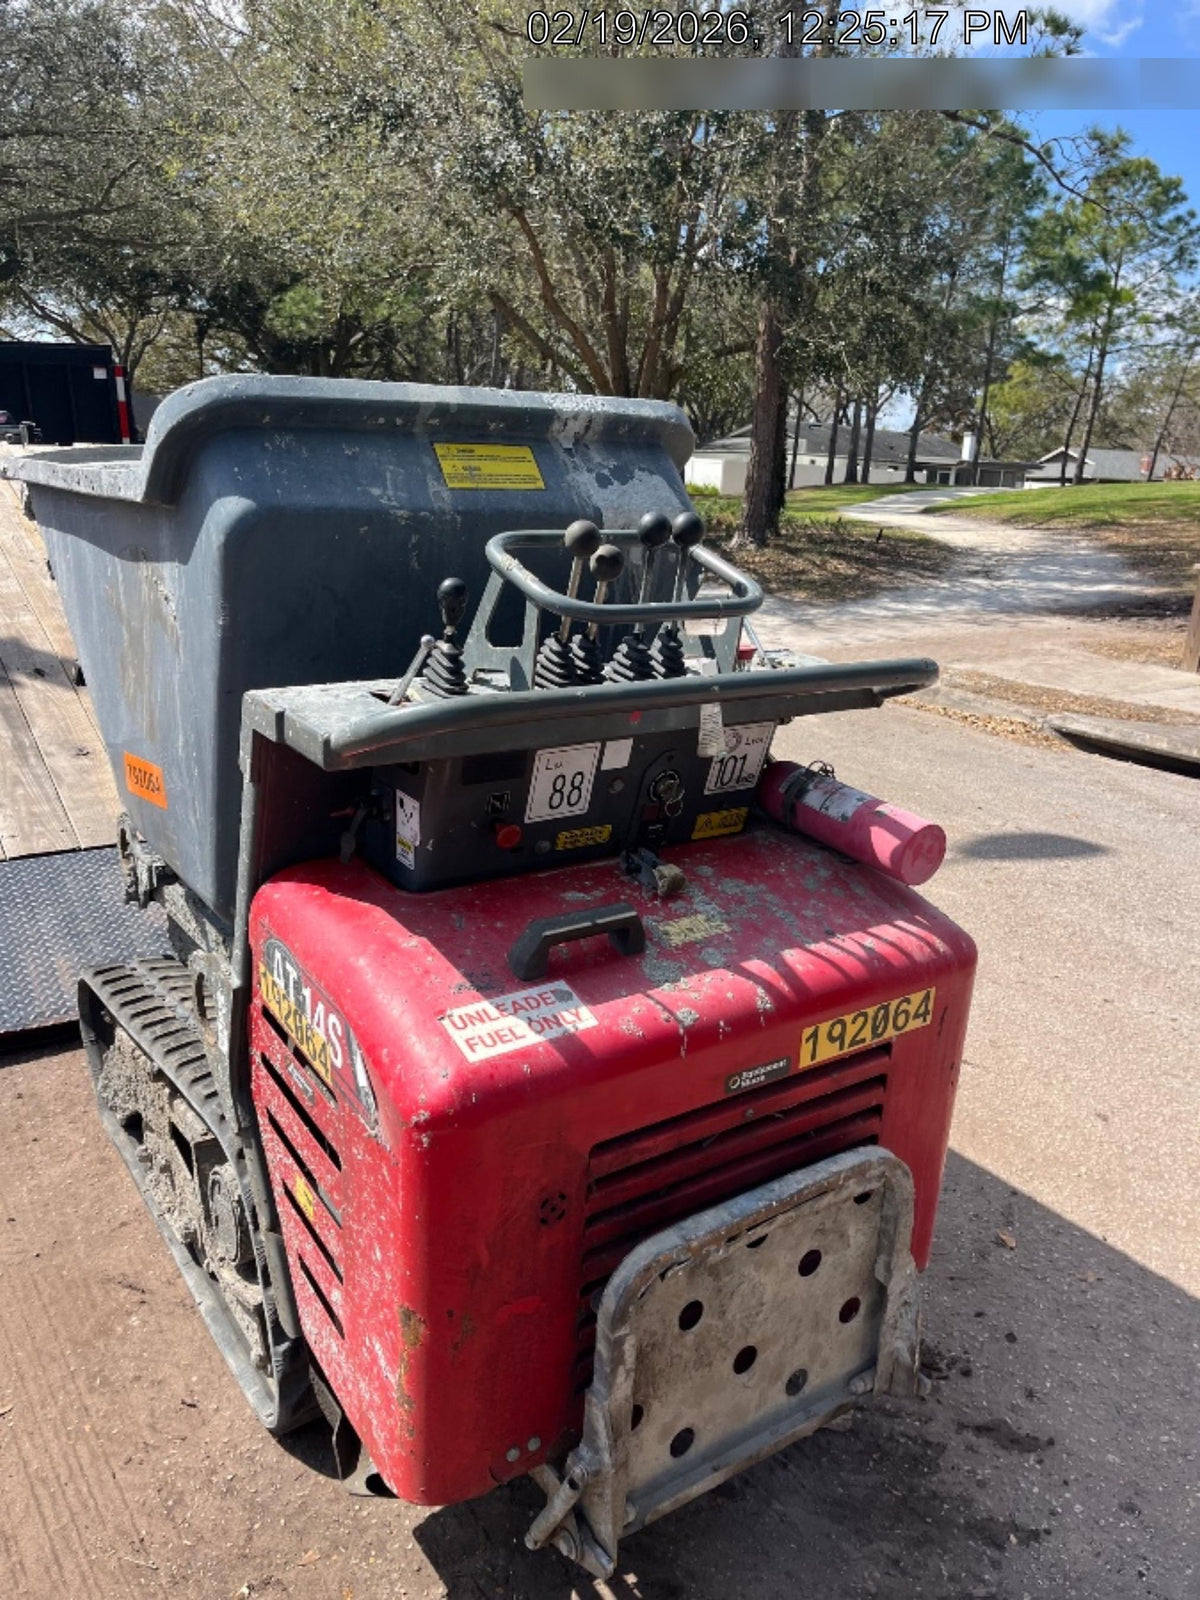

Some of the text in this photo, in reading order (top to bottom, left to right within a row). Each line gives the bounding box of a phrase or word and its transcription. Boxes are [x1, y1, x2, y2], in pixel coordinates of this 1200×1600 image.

[549, 771, 583, 809] 88
[714, 754, 748, 788] 101
[450, 988, 572, 1030] UNLEADE
[804, 989, 932, 1062] 192064
[464, 1008, 585, 1053] FUEL ONLY
